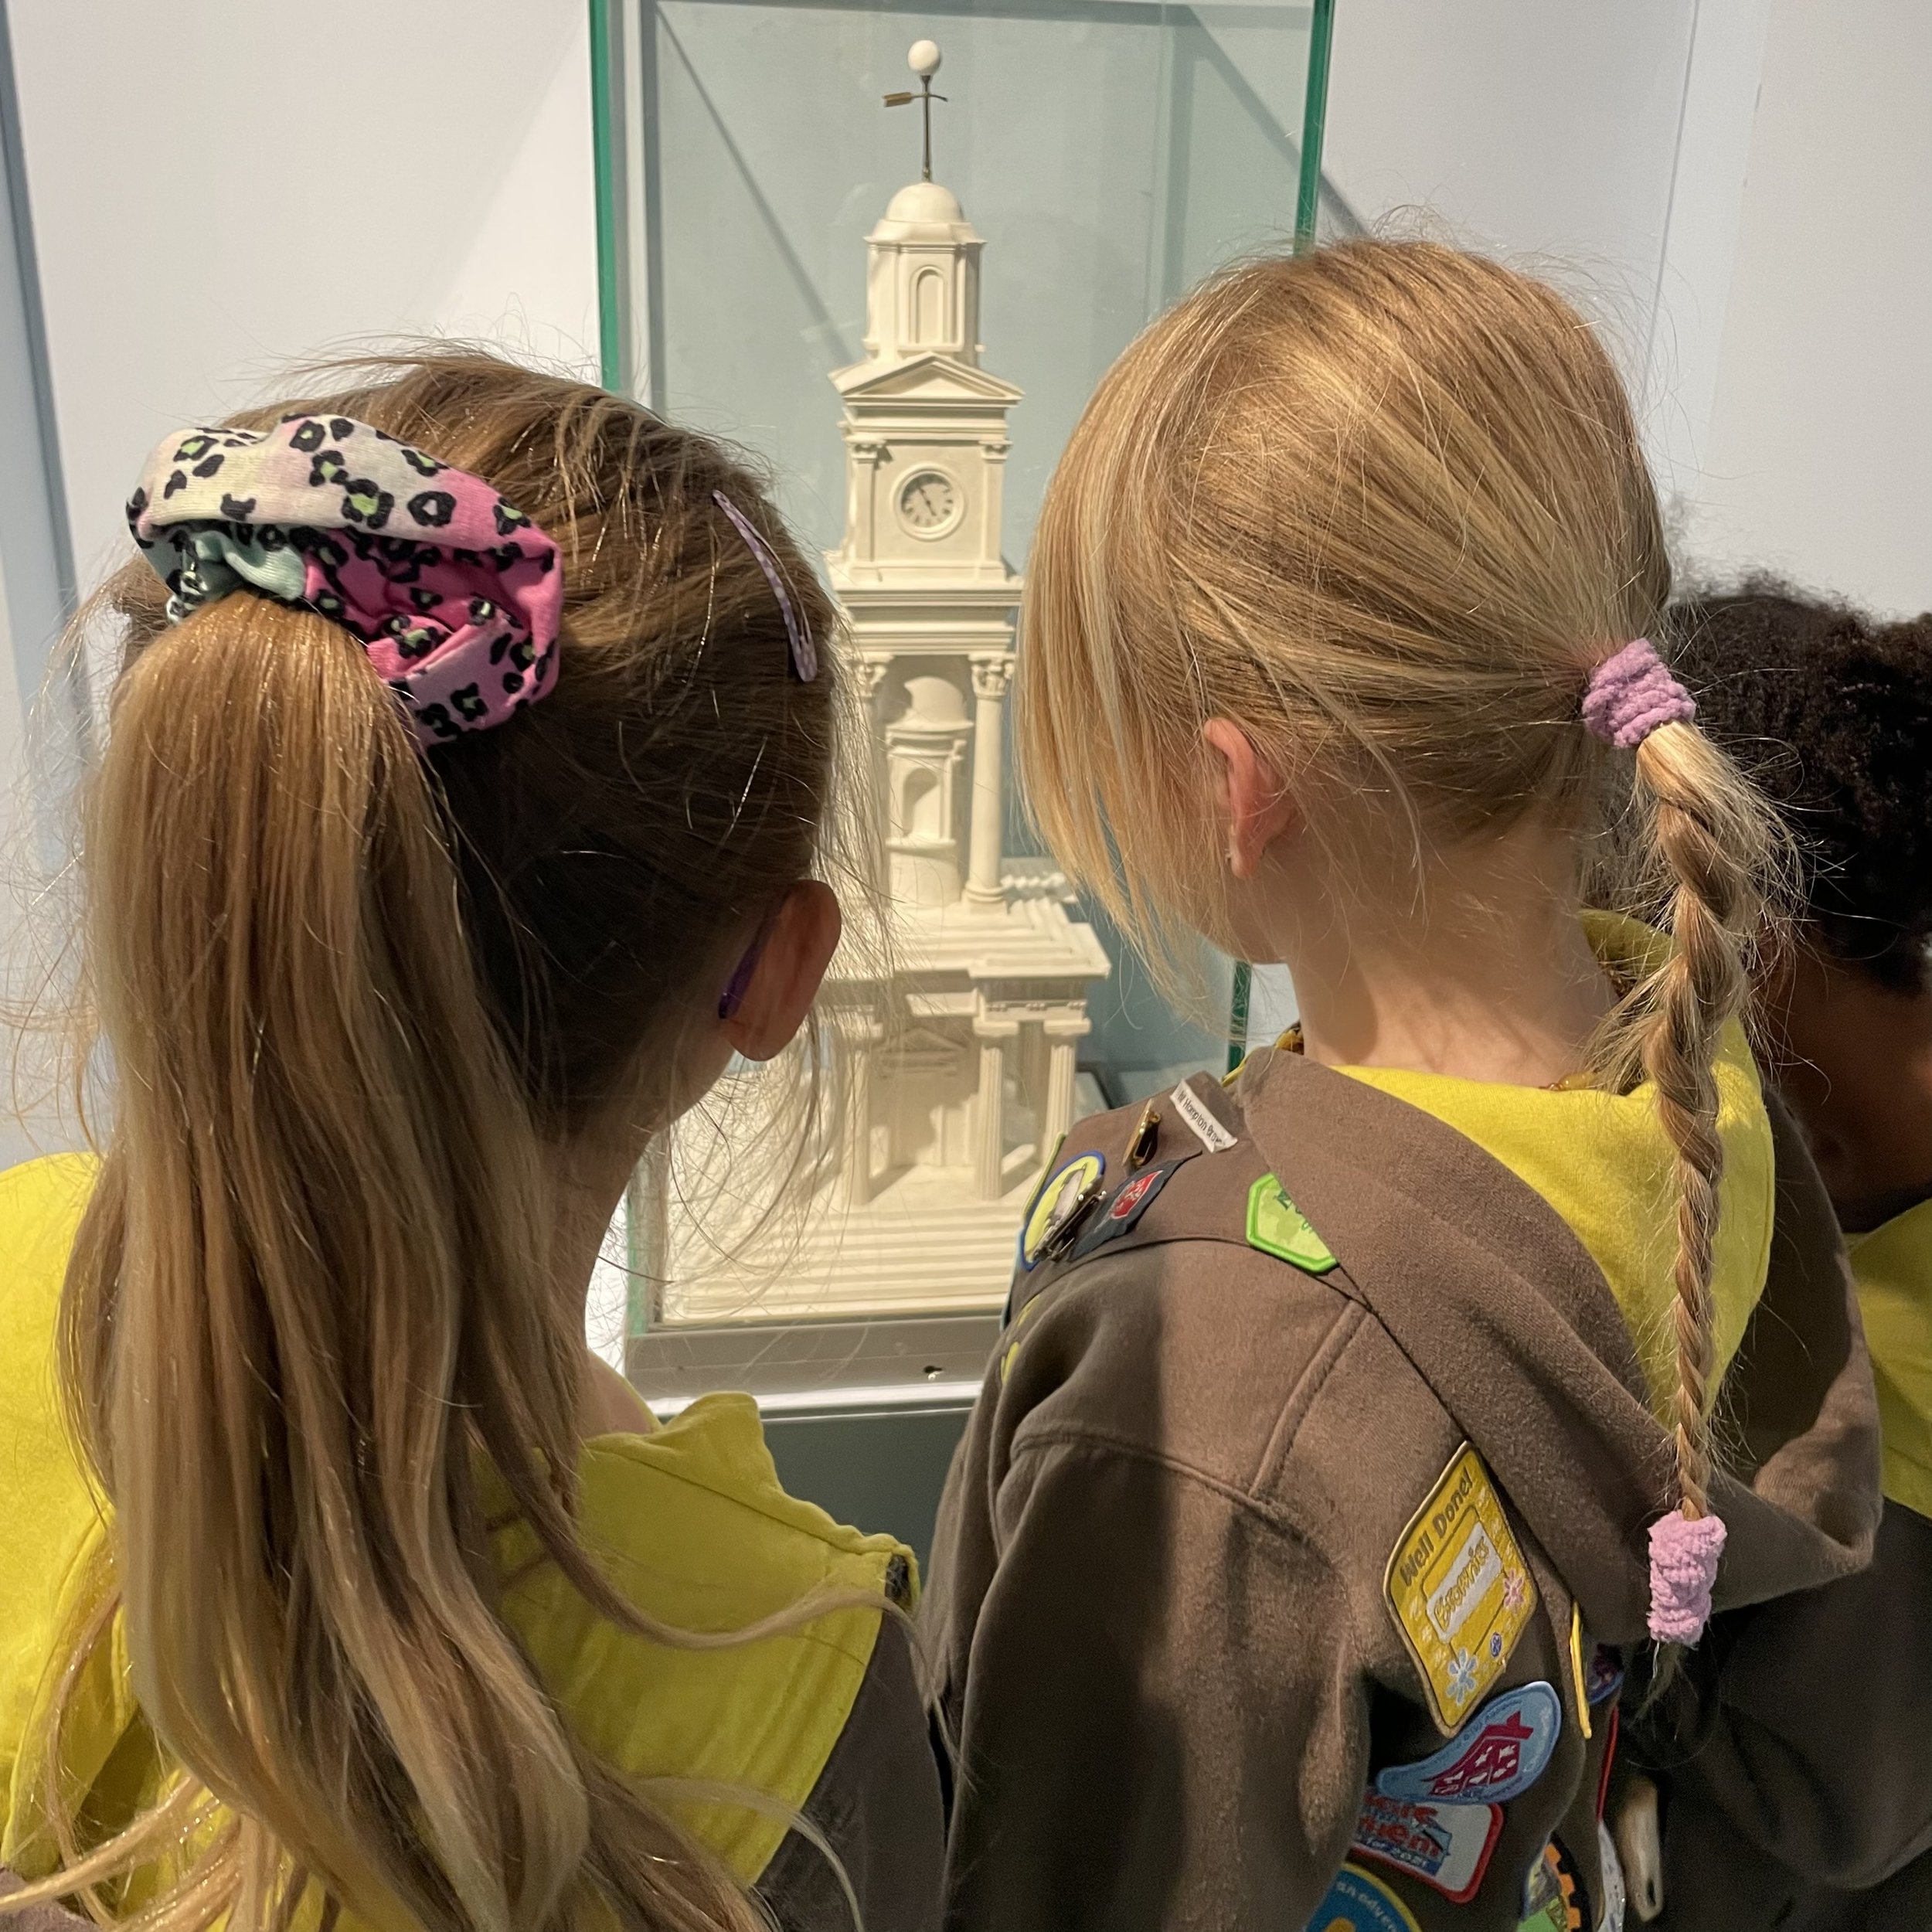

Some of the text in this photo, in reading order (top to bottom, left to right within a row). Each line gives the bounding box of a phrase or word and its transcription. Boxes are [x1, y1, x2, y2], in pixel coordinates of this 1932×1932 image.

[1182, 1098, 1208, 1131] Hampton
[1400, 1466, 1473, 1587] Well Done!
